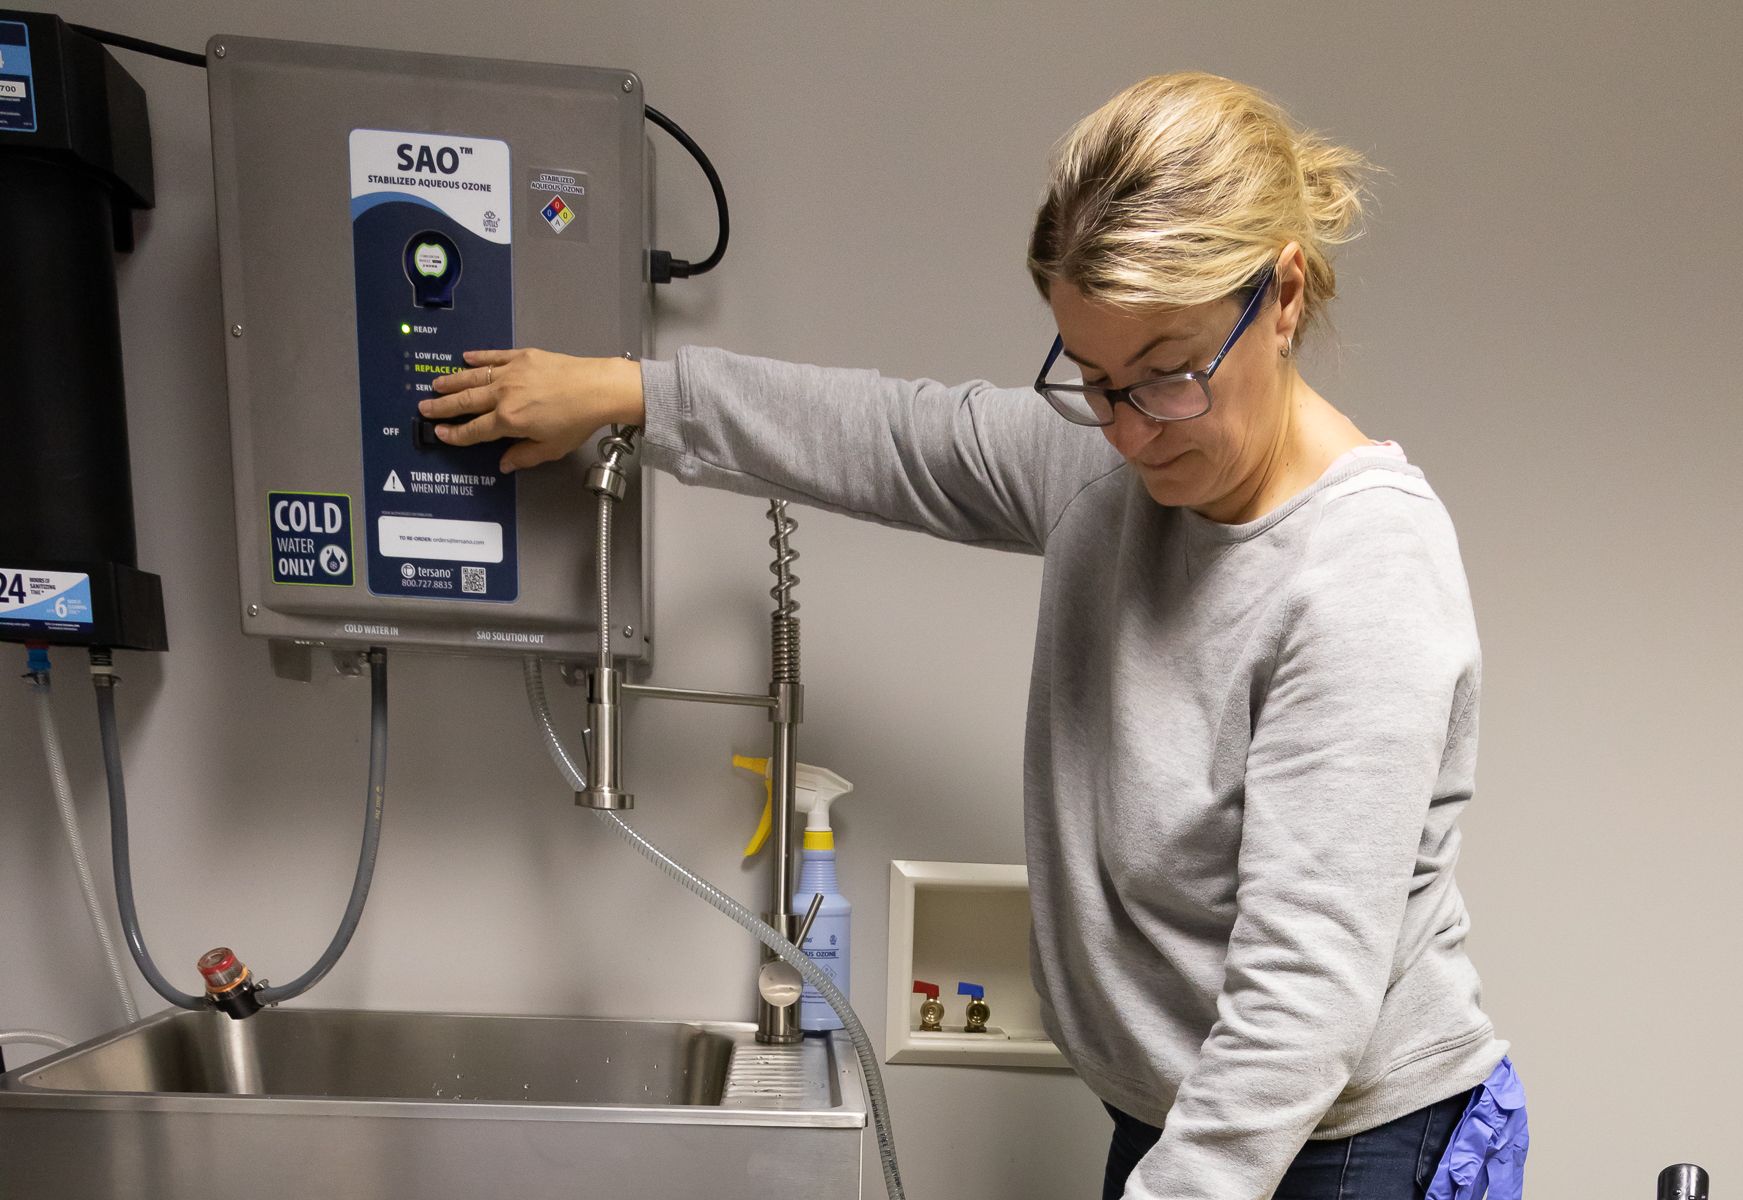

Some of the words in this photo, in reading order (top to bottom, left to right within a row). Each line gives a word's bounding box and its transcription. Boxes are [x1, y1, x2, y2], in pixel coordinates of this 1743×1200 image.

[368, 175, 416, 186] STABILIZED
[418, 178, 460, 189] AQUEOUS
[462, 182, 492, 192] OZONE
[540, 175, 575, 184] STABILIZED
[531, 182, 561, 192] AQUEOUS
[562, 186, 584, 195] OZONE
[414, 326, 438, 334] READY
[415, 352, 431, 360] LOW
[432, 353, 452, 361] FLOW
[415, 364, 450, 374] REPLACE
[383, 427, 400, 436] OFF
[410, 471, 433, 482] TURN
[435, 472, 450, 483] OFF
[451, 474, 479, 485] WATER
[480, 476, 496, 486] TAP
[411, 482, 434, 494] WHEN
[435, 484, 450, 494] NOT
[451, 485, 459, 495] IN
[460, 485, 474, 496] USE
[274, 500, 342, 534] COLD
[277, 538, 315, 554] WATER
[278, 558, 315, 576] ONLY
[401, 579, 453, 590] 800.727.8835
[55, 597, 67, 618] 6
[344, 624, 363, 634] COLD
[364, 625, 389, 635] WATER
[390, 627, 398, 636] IN
[476, 631, 491, 640] SAO
[492, 632, 528, 643] SOLUTION
[529, 634, 544, 644] OUT
